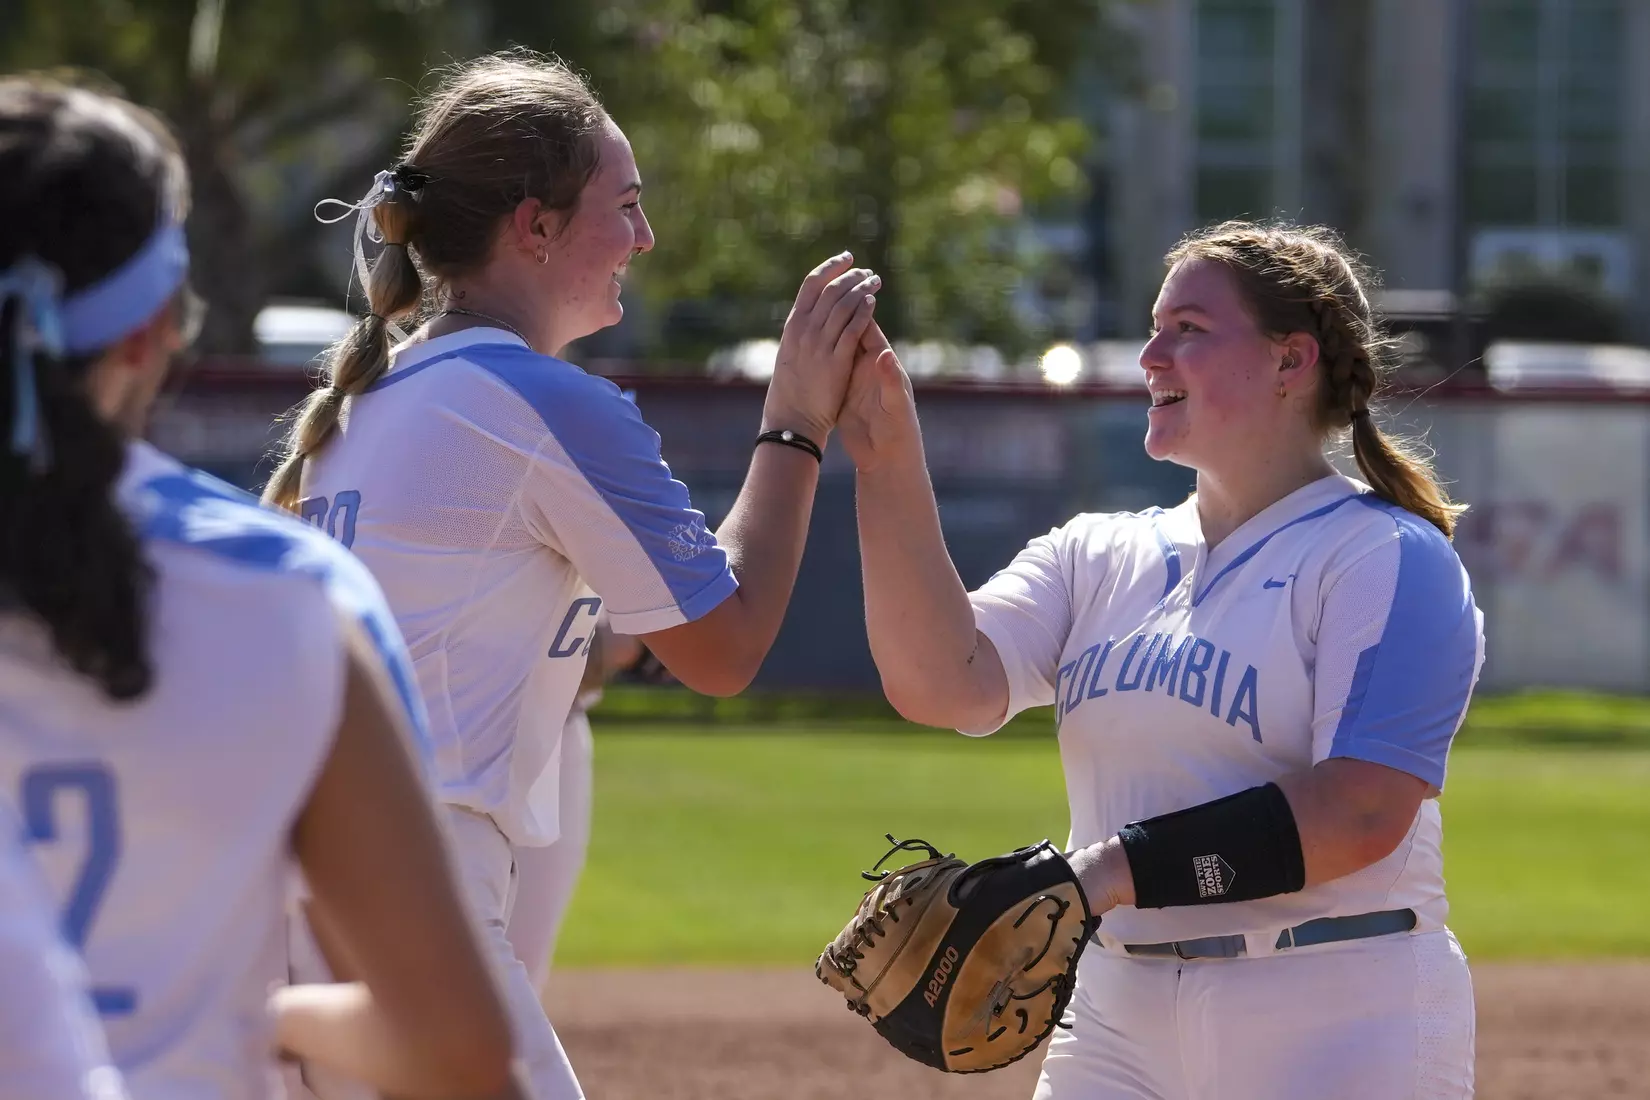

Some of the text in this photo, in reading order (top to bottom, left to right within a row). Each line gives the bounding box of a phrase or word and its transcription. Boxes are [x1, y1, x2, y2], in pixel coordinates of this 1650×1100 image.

[548, 597, 602, 658] C
[1055, 632, 1263, 744] COLUMBIA
[1195, 858, 1203, 877] THE
[1201, 857, 1216, 895] ZONE
[1210, 856, 1224, 893] SPORTS
[923, 945, 959, 1008] A2000
